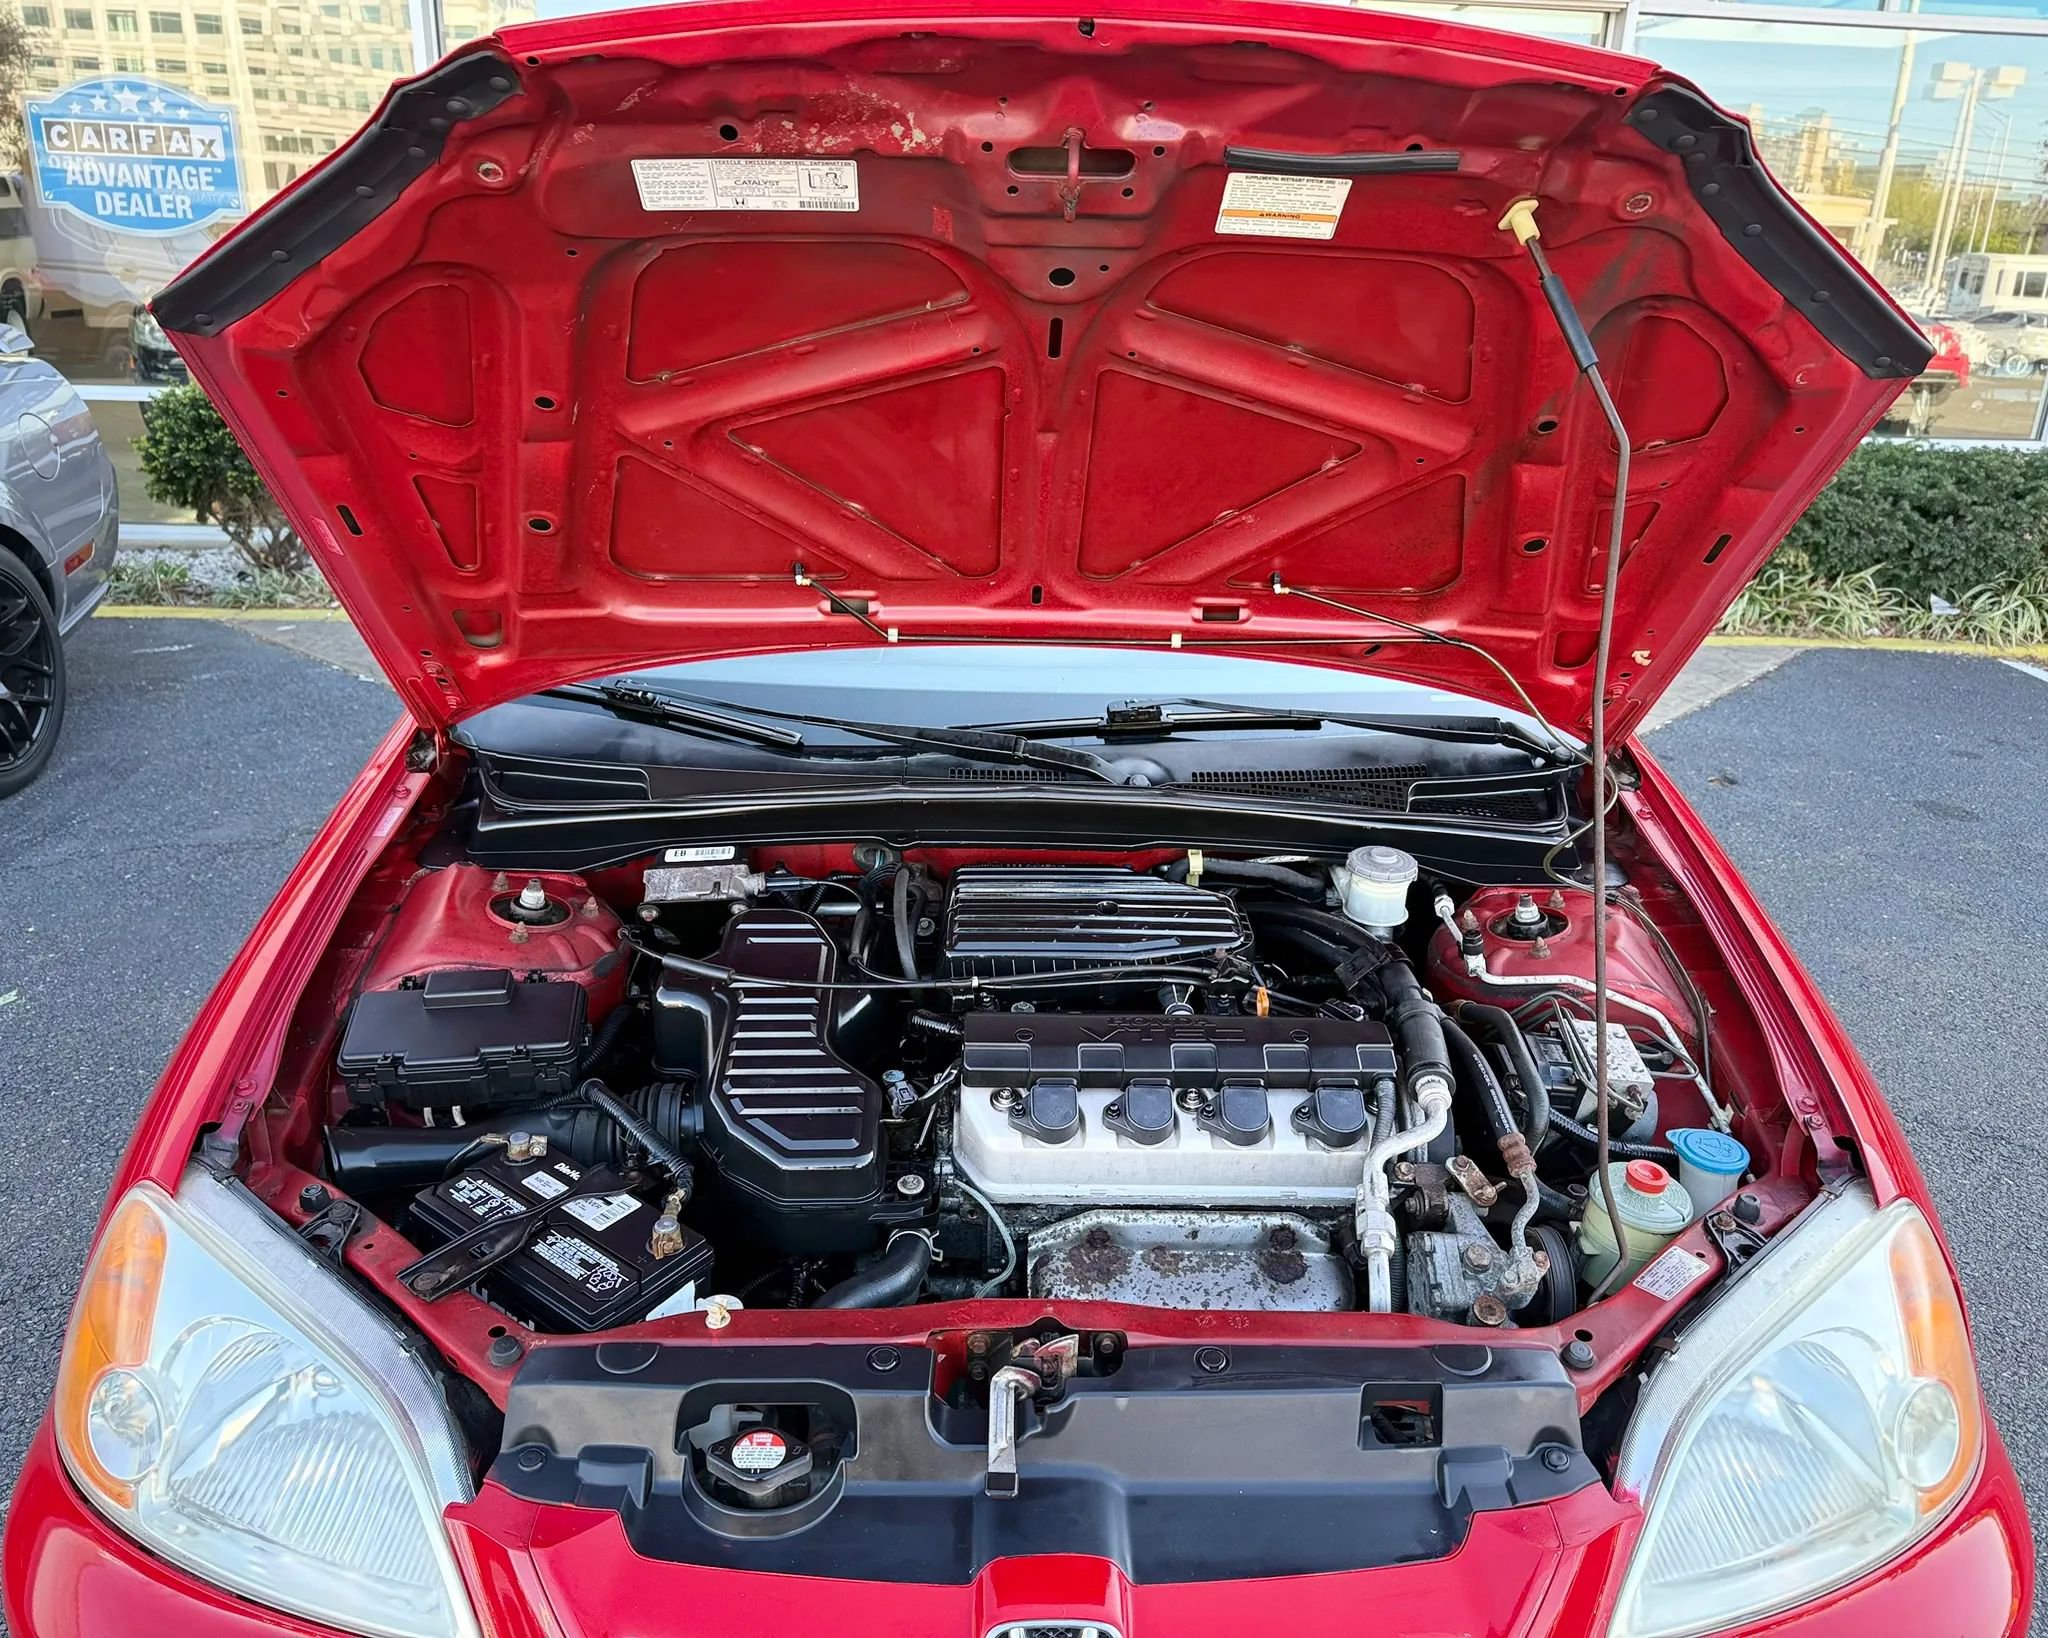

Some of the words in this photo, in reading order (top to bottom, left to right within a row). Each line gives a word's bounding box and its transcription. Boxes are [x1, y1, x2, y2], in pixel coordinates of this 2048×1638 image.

[48, 123, 217, 159] CARFAX
[734, 179, 780, 187] CATALYST
[95, 191, 194, 219] DEALER
[1266, 212, 1301, 220] WARNING
[1079, 1026, 1246, 1042] VTEC
